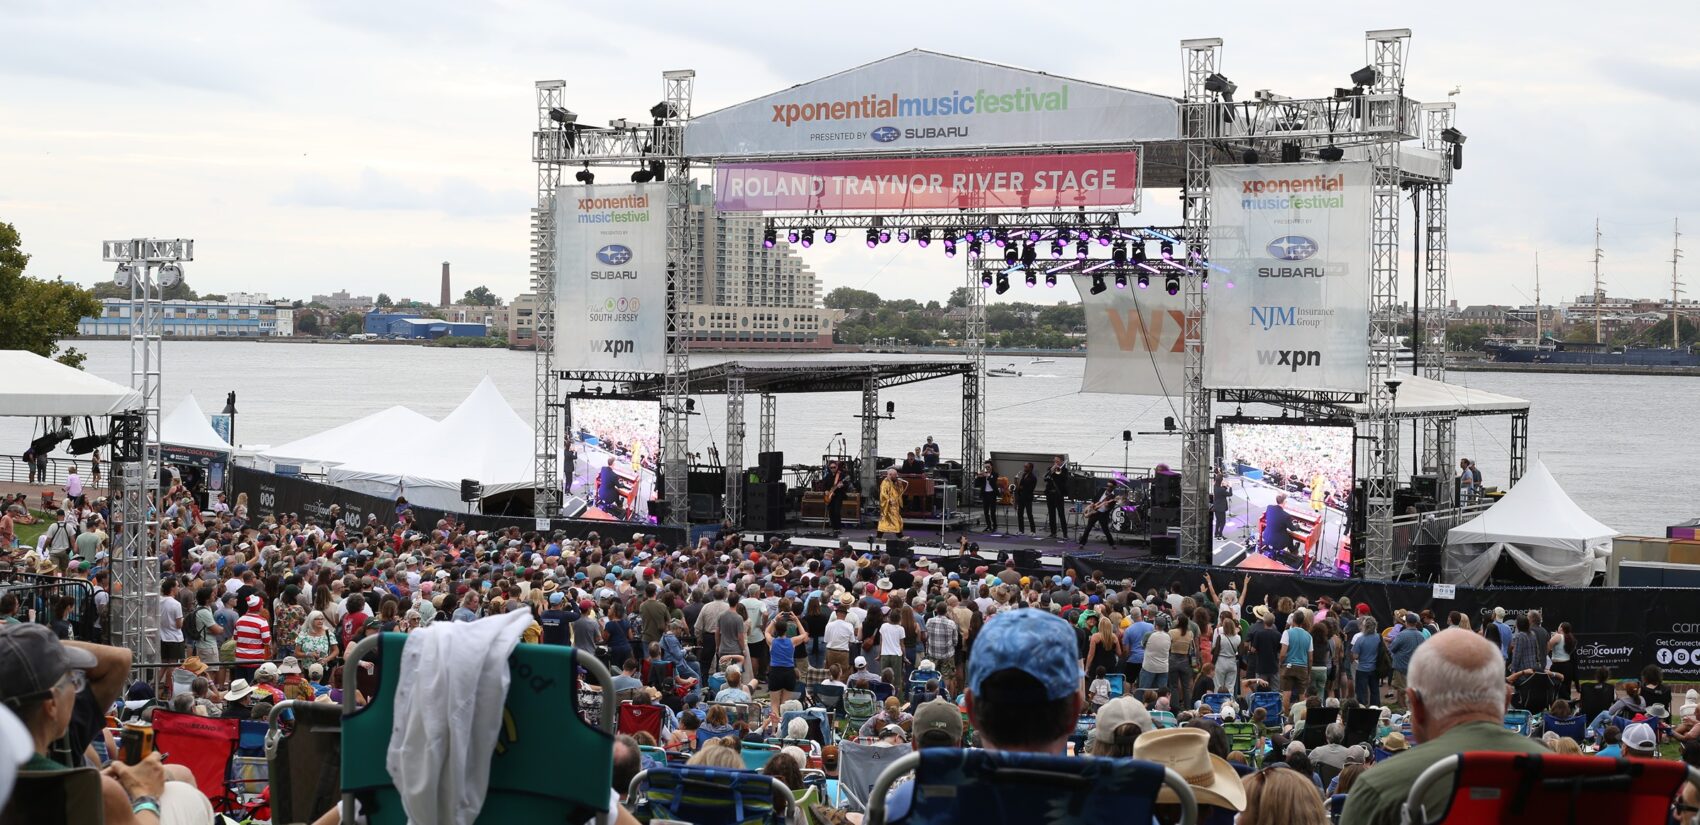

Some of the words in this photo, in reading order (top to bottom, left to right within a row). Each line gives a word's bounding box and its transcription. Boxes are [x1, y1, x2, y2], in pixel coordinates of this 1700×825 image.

[810, 131, 855, 142] PRESENTED
[857, 131, 867, 140] BY
[905, 126, 968, 139] SUBARU
[731, 175, 825, 197] ROLAND
[832, 173, 943, 195] TRAYNOR
[952, 171, 1025, 193] RIVER
[1034, 169, 1116, 192] STAGE
[1242, 174, 1343, 195] xponential
[578, 193, 649, 212] xponential
[1242, 194, 1344, 210] musicfestival
[578, 211, 650, 223] musicfestival
[590, 271, 637, 280] SUBARU
[1258, 267, 1325, 278] SUBARU
[1297, 306, 1335, 316] Insurance
[589, 313, 612, 322] SOUTH
[614, 313, 639, 322] JERSEY
[1249, 306, 1296, 331] NJM
[1296, 318, 1320, 328] Group
[590, 339, 634, 358] wxpn
[1257, 349, 1321, 372] wxpn
[1656, 639, 1669, 647] Get
[1599, 646, 1633, 657] county
